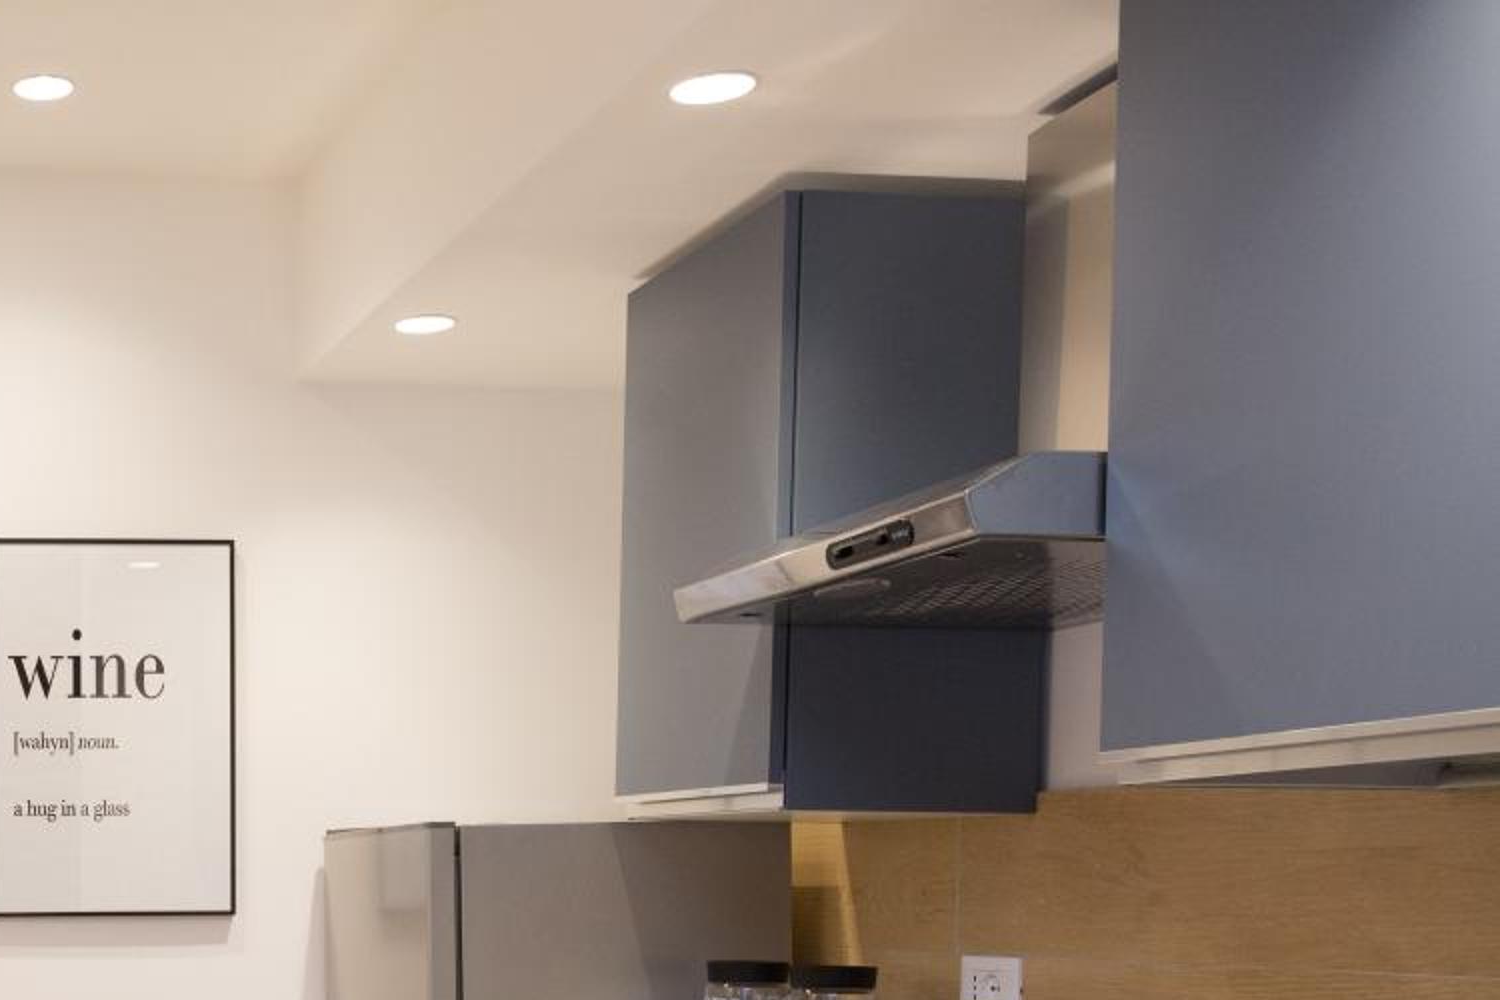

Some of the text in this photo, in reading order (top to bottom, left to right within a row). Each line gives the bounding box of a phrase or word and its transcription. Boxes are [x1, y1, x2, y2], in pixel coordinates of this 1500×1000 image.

[7, 628, 165, 700] wine
[13, 731, 120, 756] [wahyn] noun.
[13, 800, 131, 822] a hug in a glass
